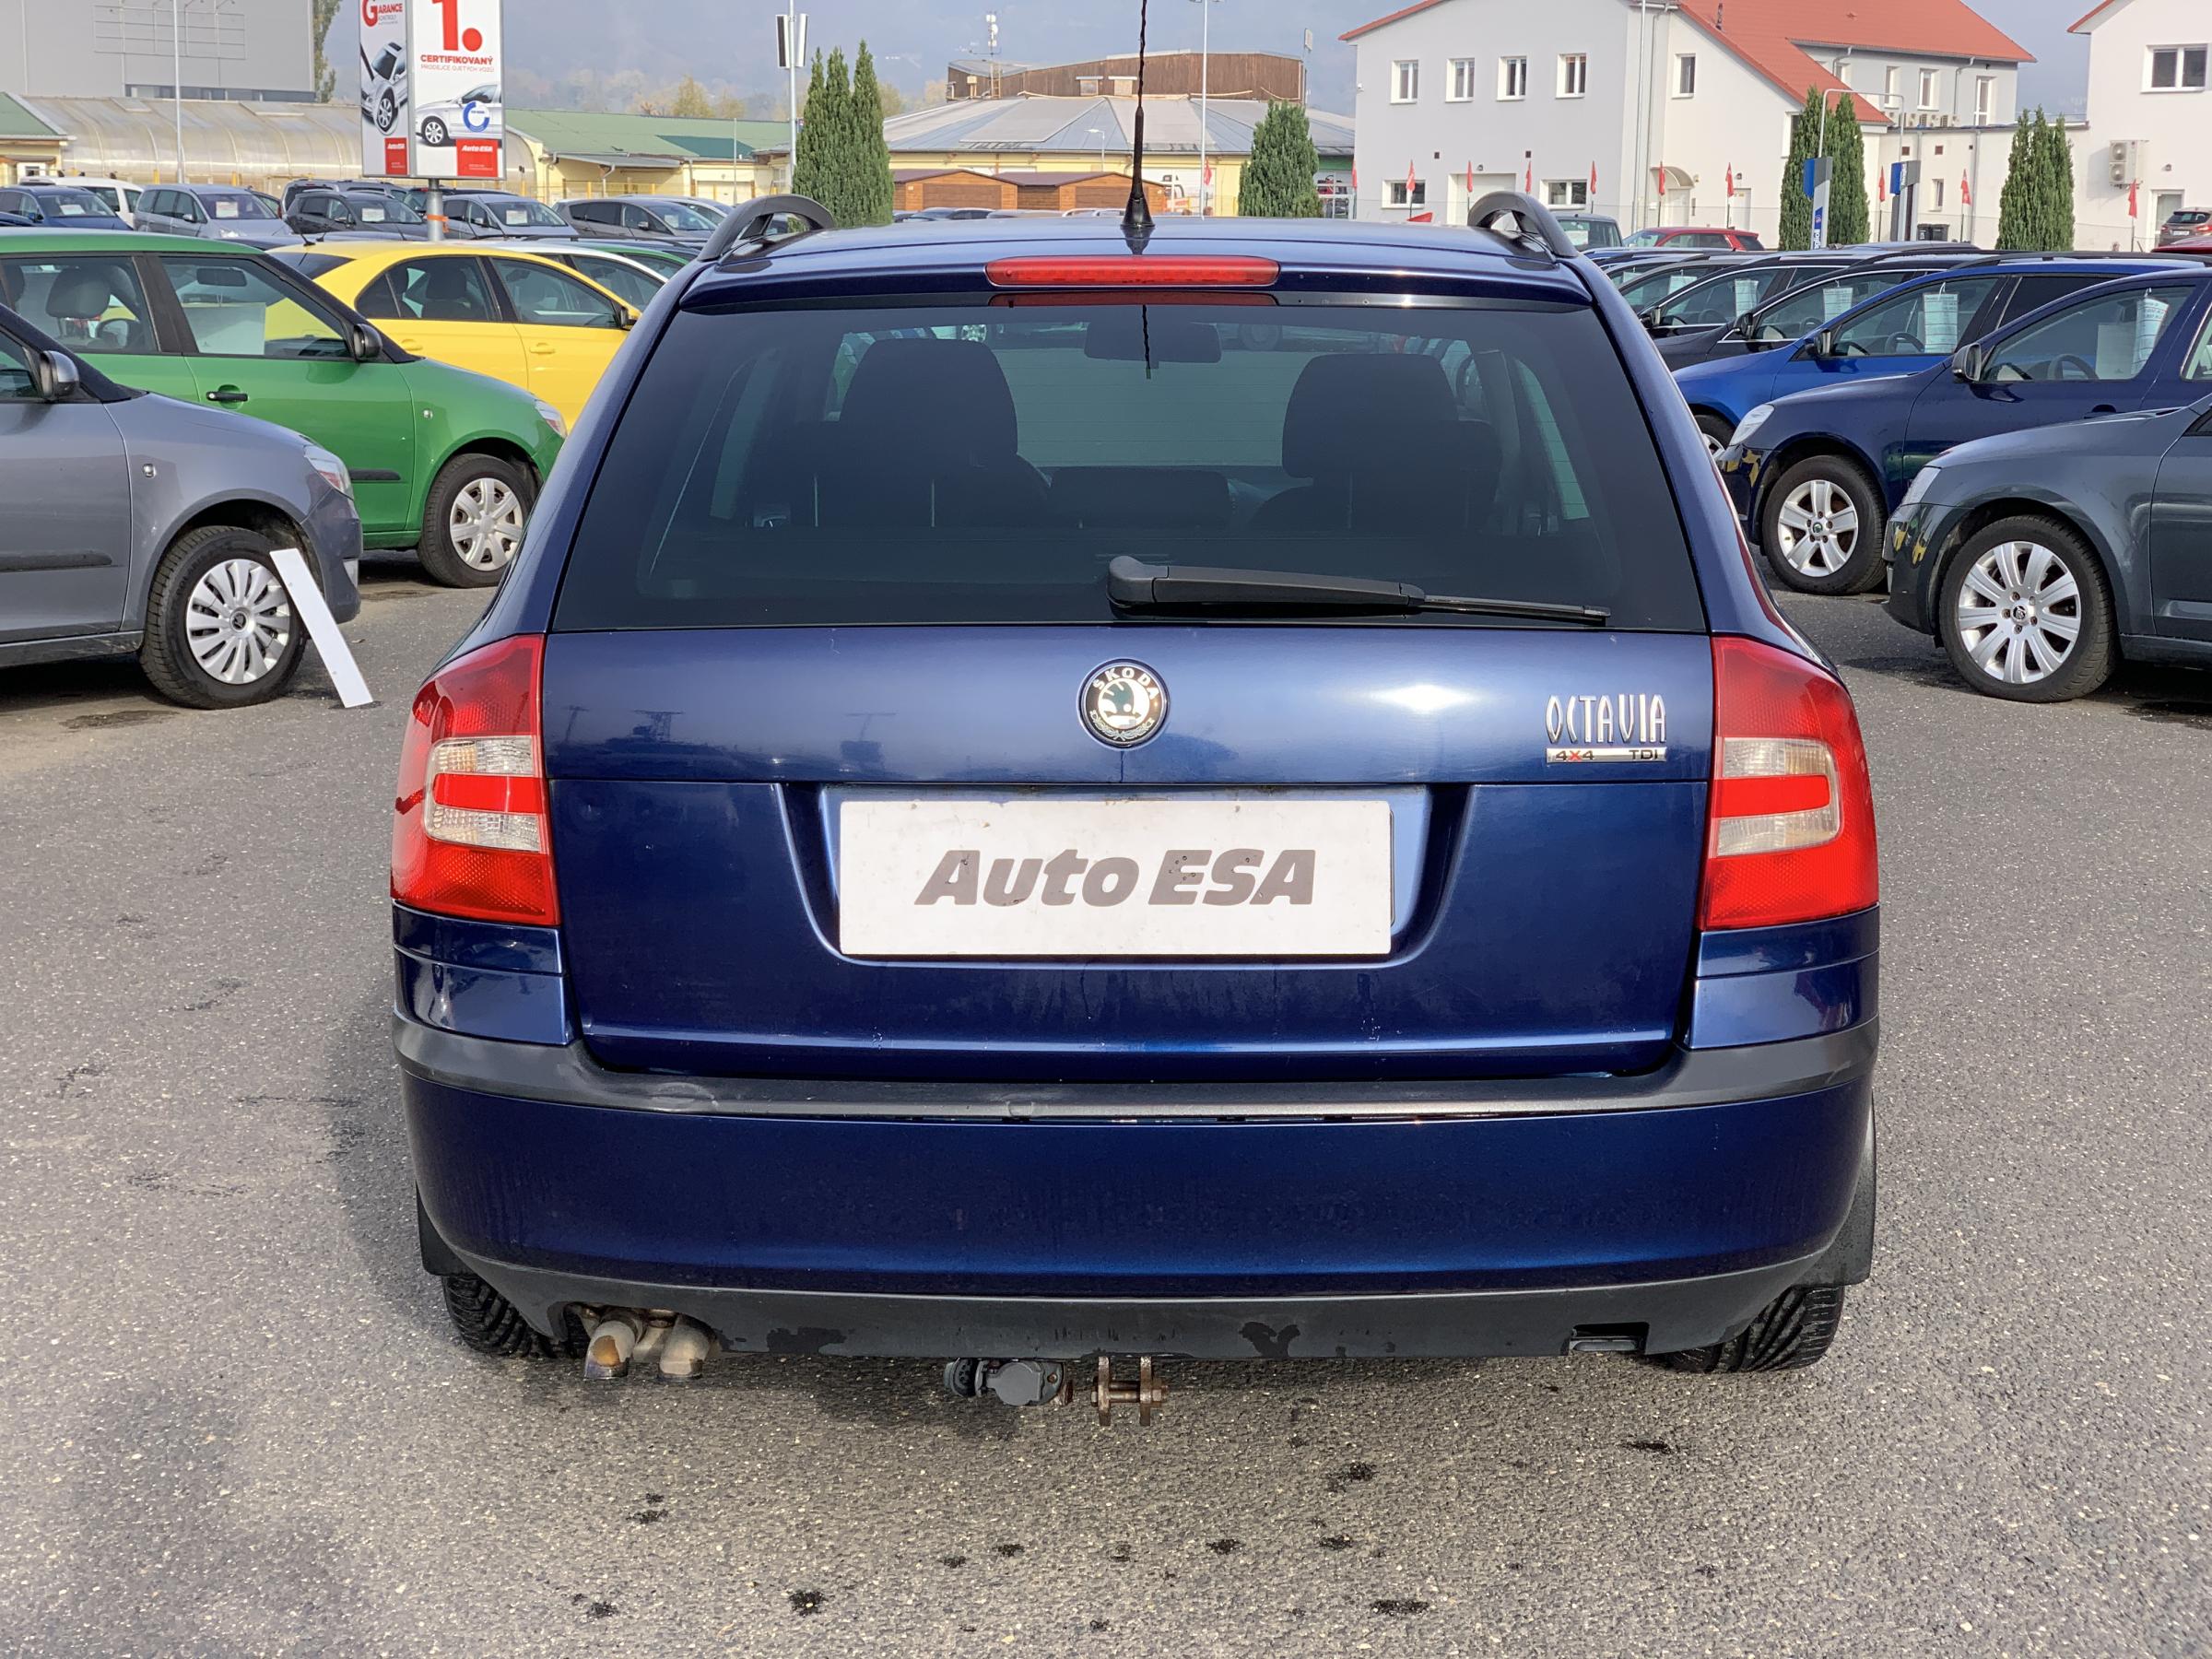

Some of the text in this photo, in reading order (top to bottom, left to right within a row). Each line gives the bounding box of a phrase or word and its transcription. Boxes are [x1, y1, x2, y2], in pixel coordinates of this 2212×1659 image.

[420, 54, 493, 65] CERTIFIKOVANÝ
[1546, 694, 1666, 743] OCTAVIA
[1629, 749, 1658, 760] TDI
[914, 848, 1316, 906] Auto ESA
